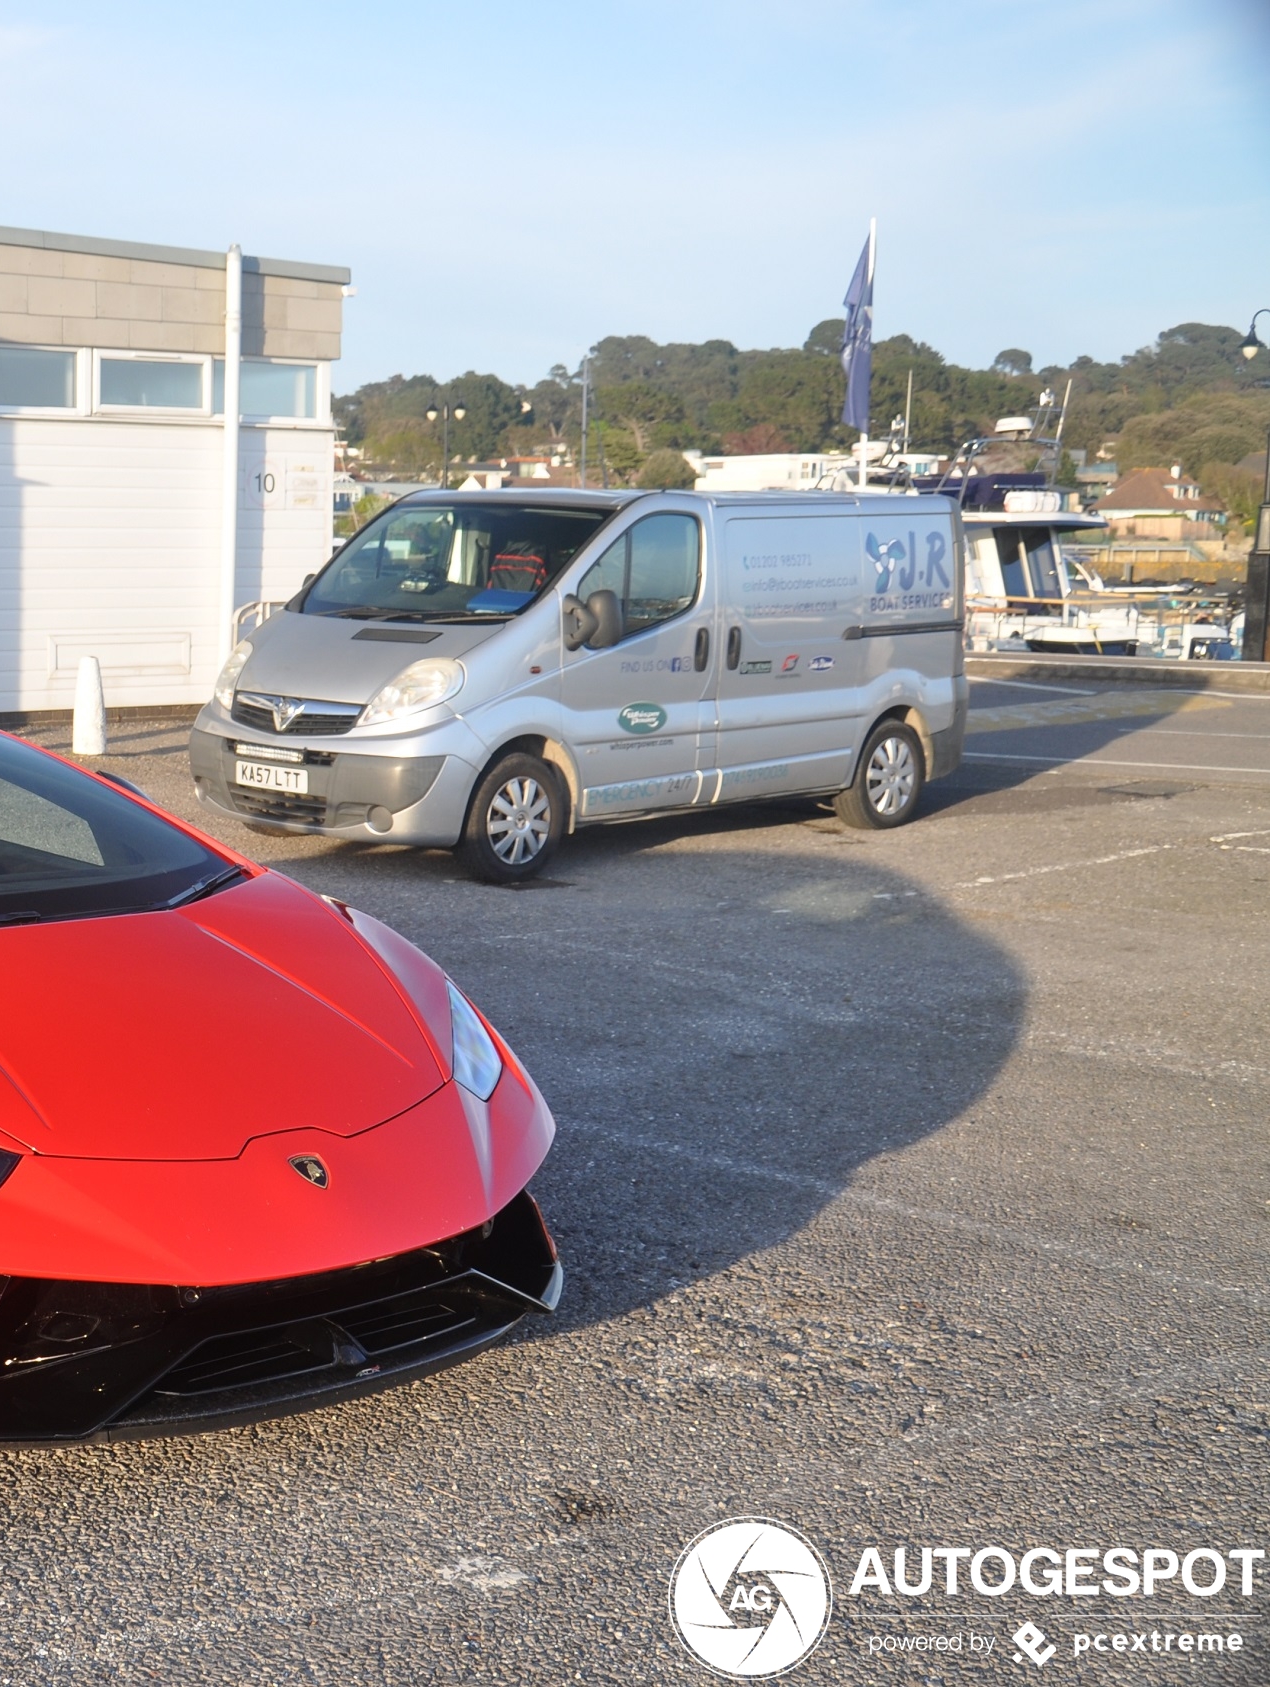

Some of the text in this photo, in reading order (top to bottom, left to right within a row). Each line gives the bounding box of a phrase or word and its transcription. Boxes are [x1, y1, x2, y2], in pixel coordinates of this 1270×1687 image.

[255, 472, 275, 493] 10
[898, 530, 950, 591] J.R
[869, 596, 900, 612] BOAT
[620, 660, 641, 673] FIND
[643, 659, 654, 672] US
[609, 737, 674, 752] whisperpower.com
[241, 764, 301, 788] KA57 LTT
[587, 779, 662, 807] EMERGENCY
[667, 775, 692, 793] 24/7
